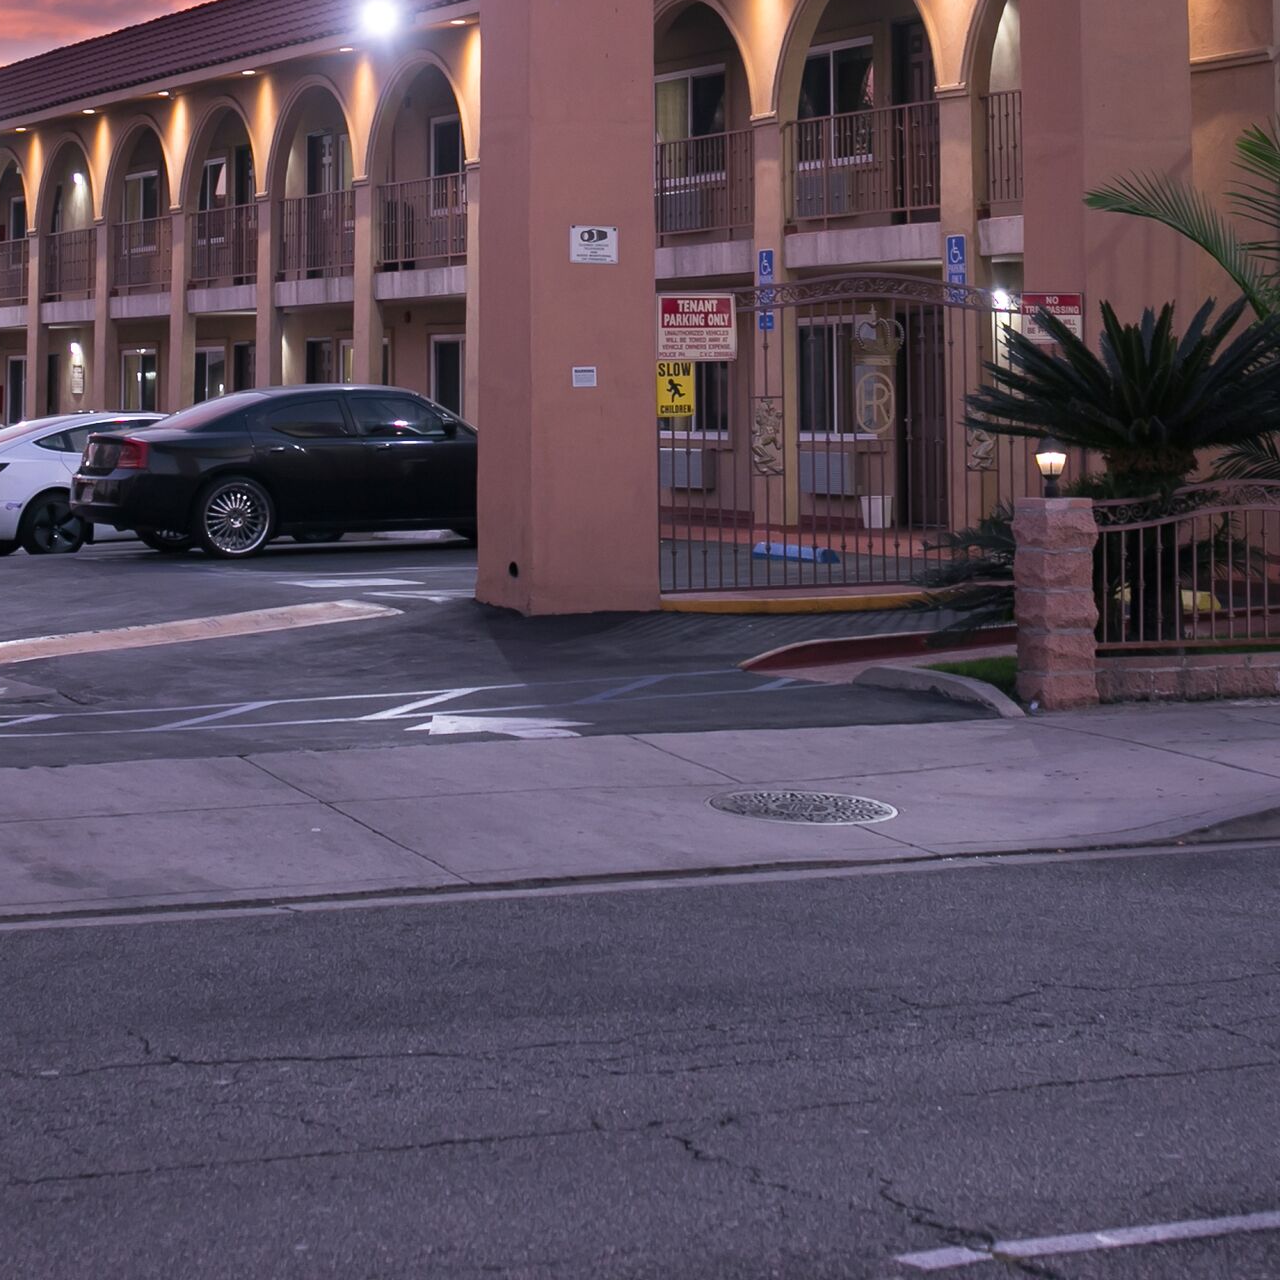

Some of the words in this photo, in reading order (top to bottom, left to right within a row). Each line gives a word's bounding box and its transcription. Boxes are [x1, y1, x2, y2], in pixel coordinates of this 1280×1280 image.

[677, 300, 718, 312] TENANT
[1045, 296, 1059, 305] NO
[663, 313, 705, 327] PARKING
[707, 313, 730, 327] ONLY
[658, 362, 692, 377] SLOW
[660, 404, 692, 414] CHILDREN
